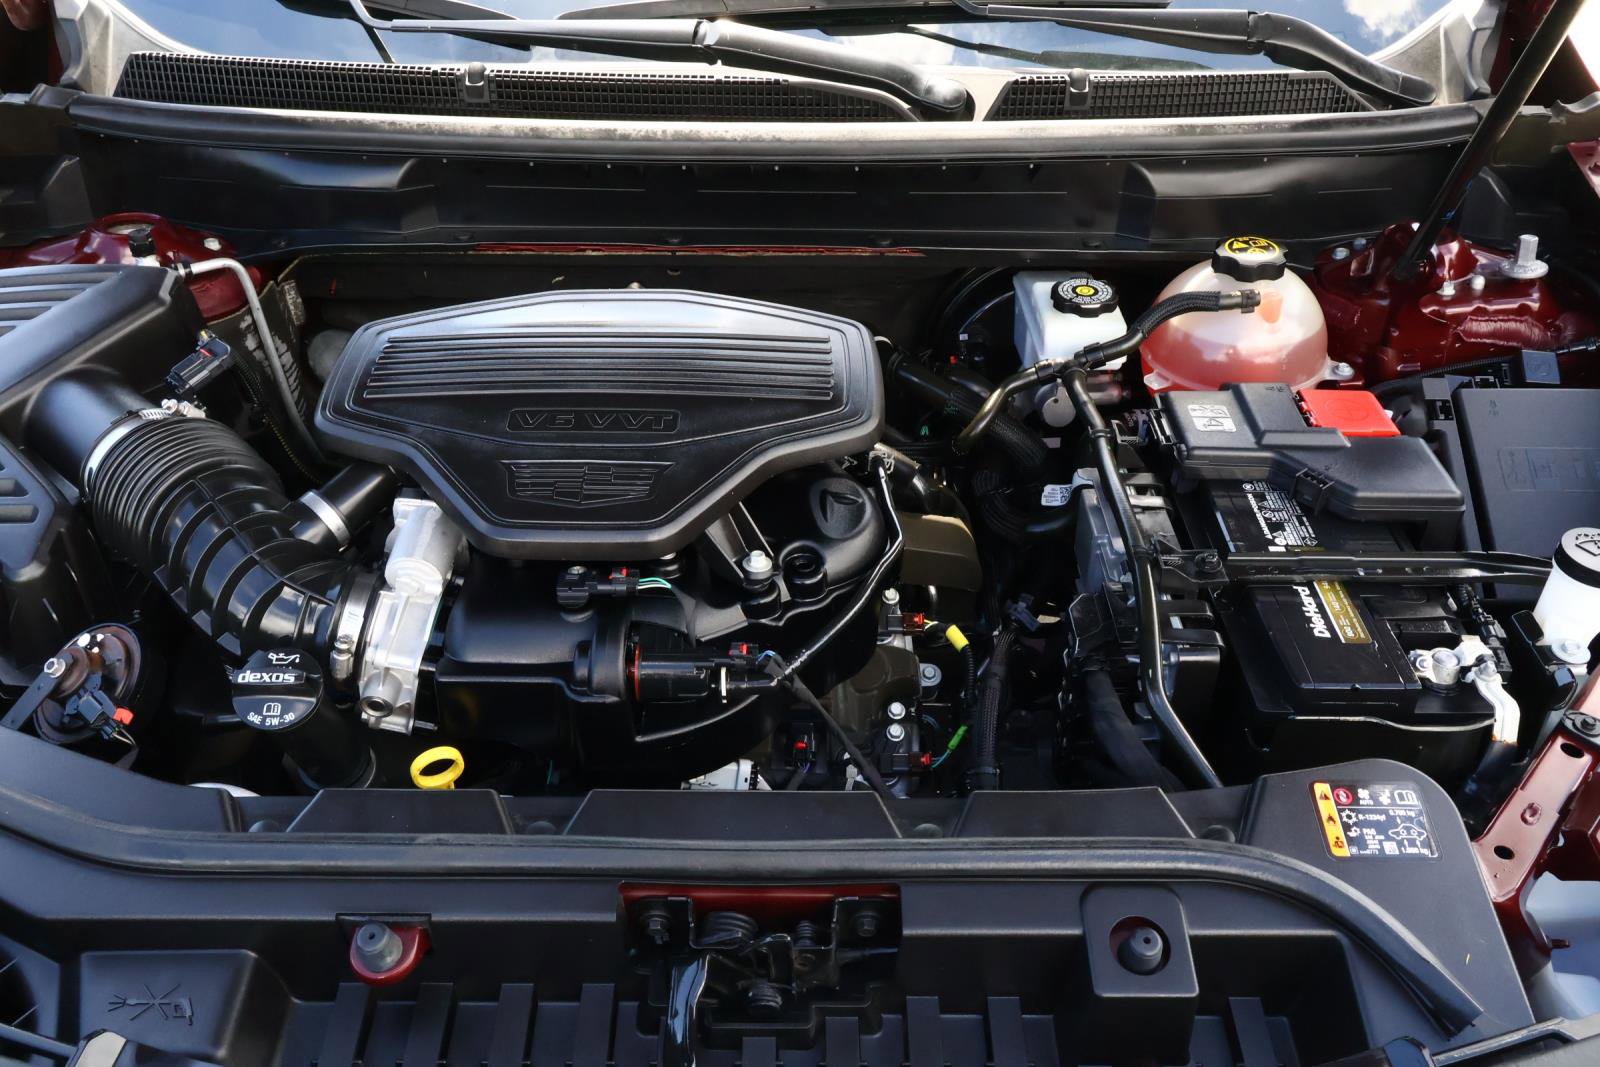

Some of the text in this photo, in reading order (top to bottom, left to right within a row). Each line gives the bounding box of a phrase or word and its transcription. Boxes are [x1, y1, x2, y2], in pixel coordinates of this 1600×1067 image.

[515, 411, 674, 430] V6 VVT
[1292, 585, 1332, 638] DieHard
[237, 670, 296, 683] dexos
[247, 711, 295, 726] SAE 5W-30
